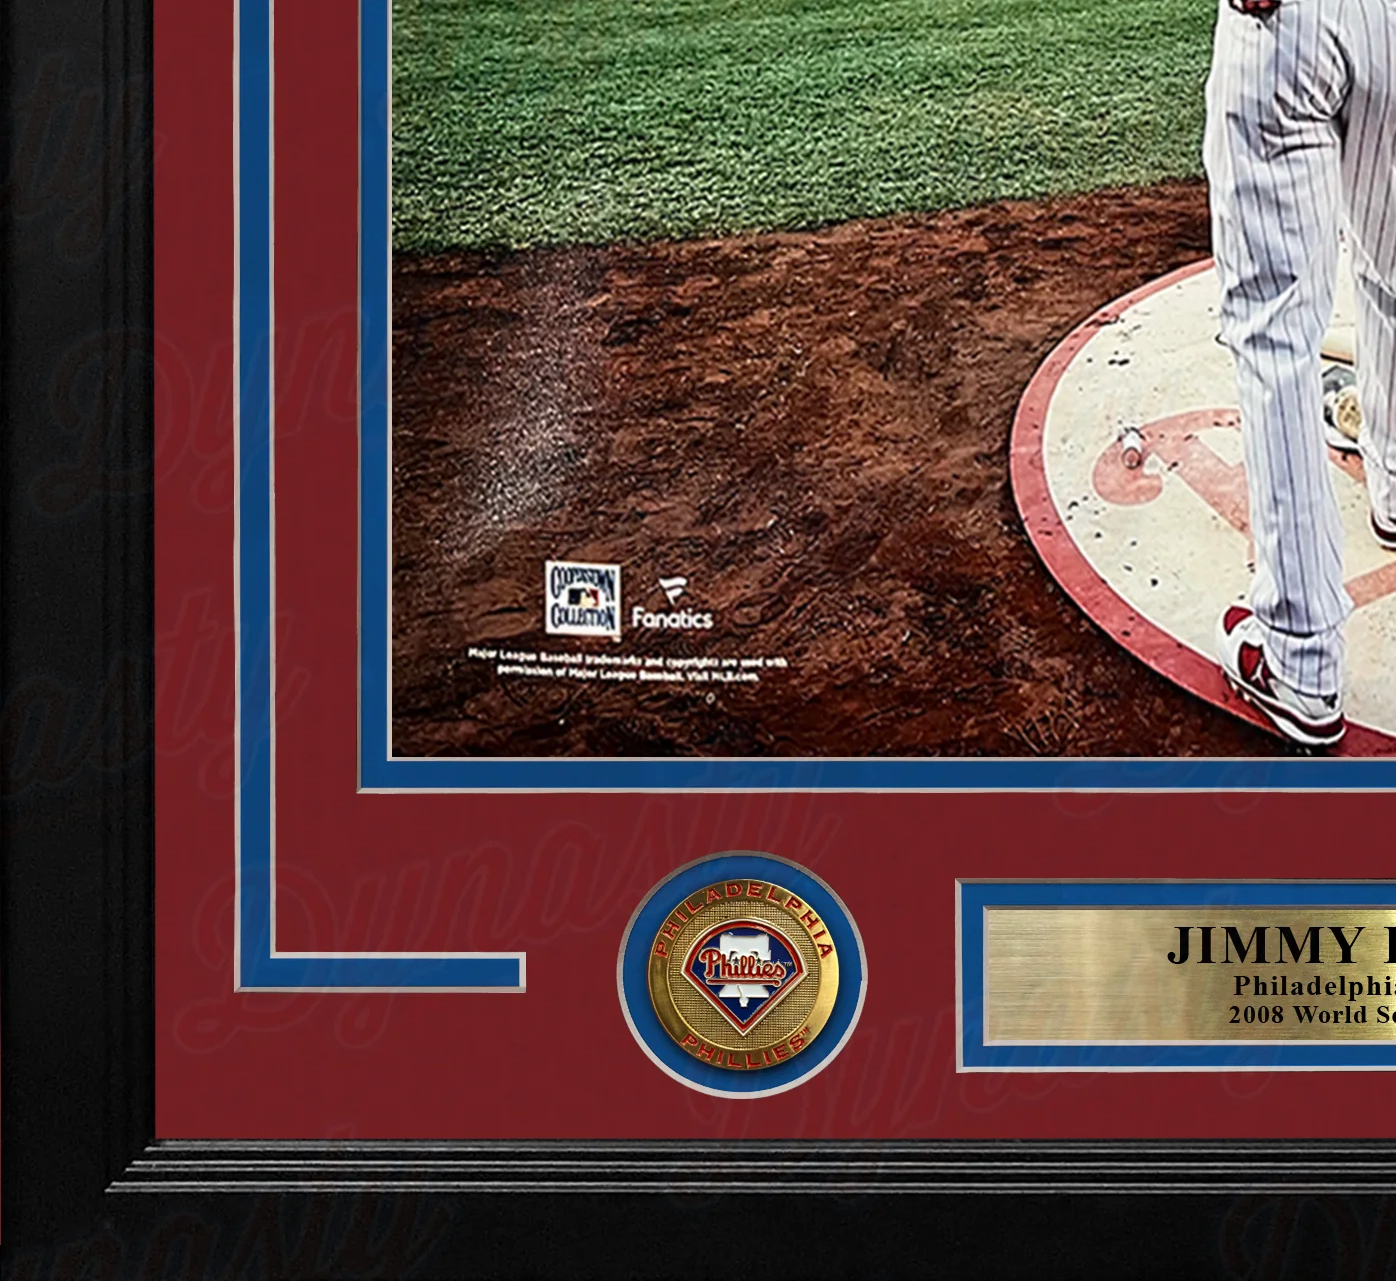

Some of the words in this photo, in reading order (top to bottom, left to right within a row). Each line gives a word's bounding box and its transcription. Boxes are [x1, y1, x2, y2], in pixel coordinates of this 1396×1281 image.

[551, 603, 616, 631] COLLECTION
[632, 606, 714, 630] Fanatics
[655, 882, 833, 959] PHILADELPHIA
[1167, 926, 1366, 965] JIMMY
[699, 947, 787, 980] Phillies
[1228, 1005, 1284, 1024] 2008
[1292, 1005, 1368, 1024] World
